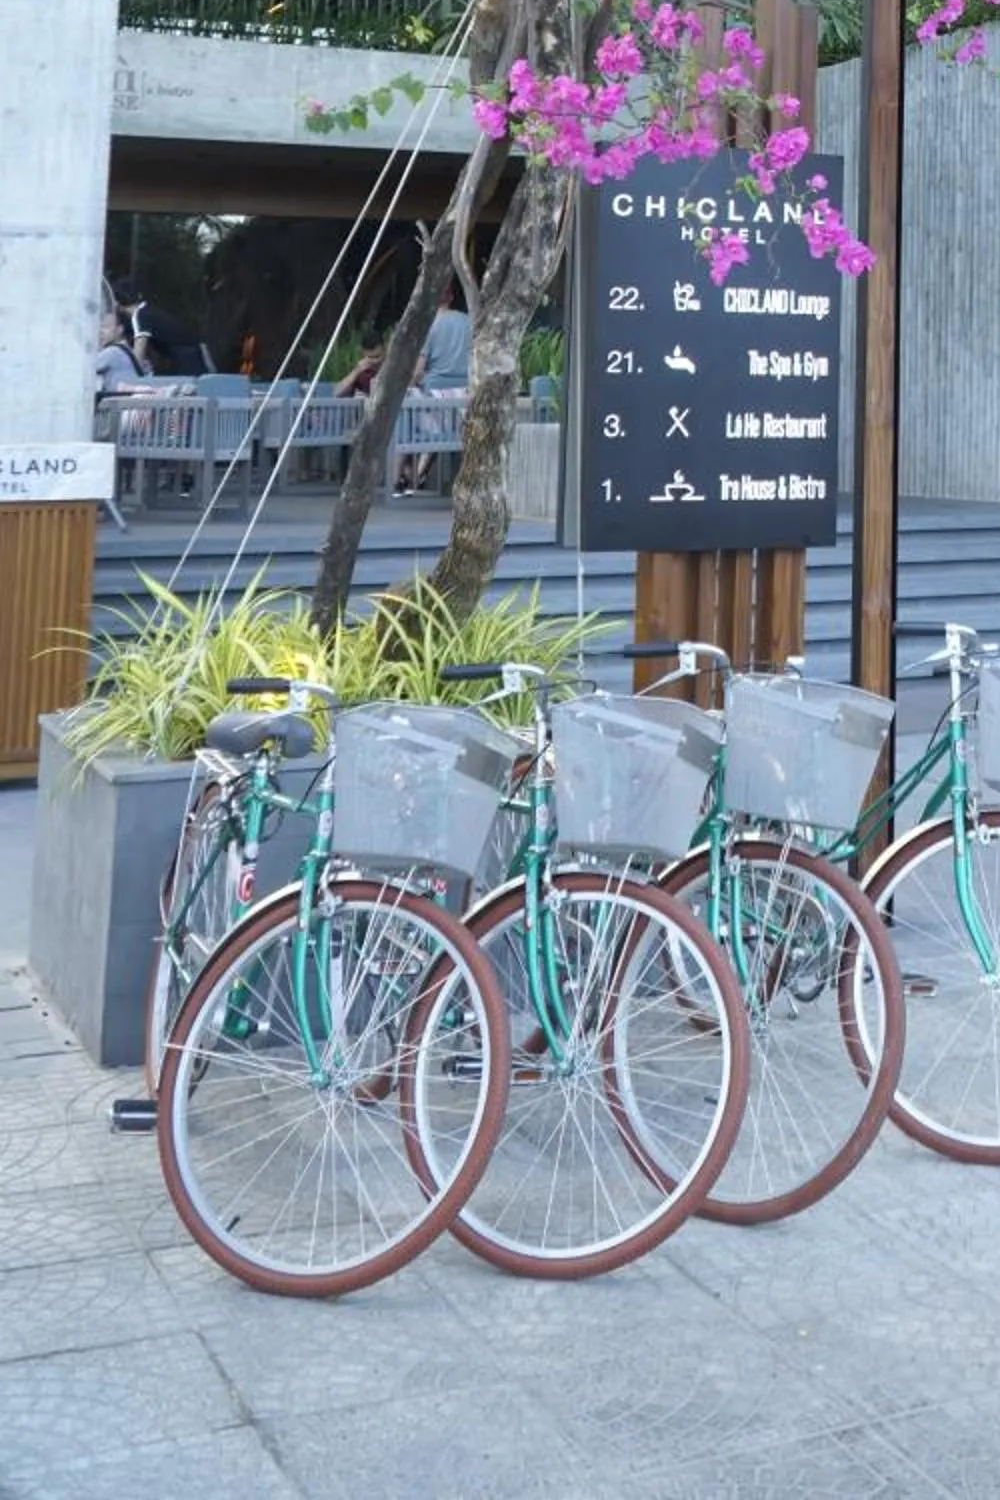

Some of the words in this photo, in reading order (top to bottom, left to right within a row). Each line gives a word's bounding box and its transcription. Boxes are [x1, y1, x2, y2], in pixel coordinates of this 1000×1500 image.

[608, 287, 645, 311] 22.
[724, 288, 788, 315] CHICLAND
[790, 291, 830, 321] Lounge
[606, 350, 643, 374] 21.
[748, 349, 768, 376] The
[769, 351, 791, 381] Spa
[793, 353, 802, 377] &
[803, 353, 829, 382] Gym
[603, 414, 626, 438] 3.
[763, 412, 827, 439] Restaurant
[601, 479, 621, 502] 1.
[741, 475, 776, 501] House
[777, 475, 788, 501] &
[789, 475, 826, 502] Bistro
